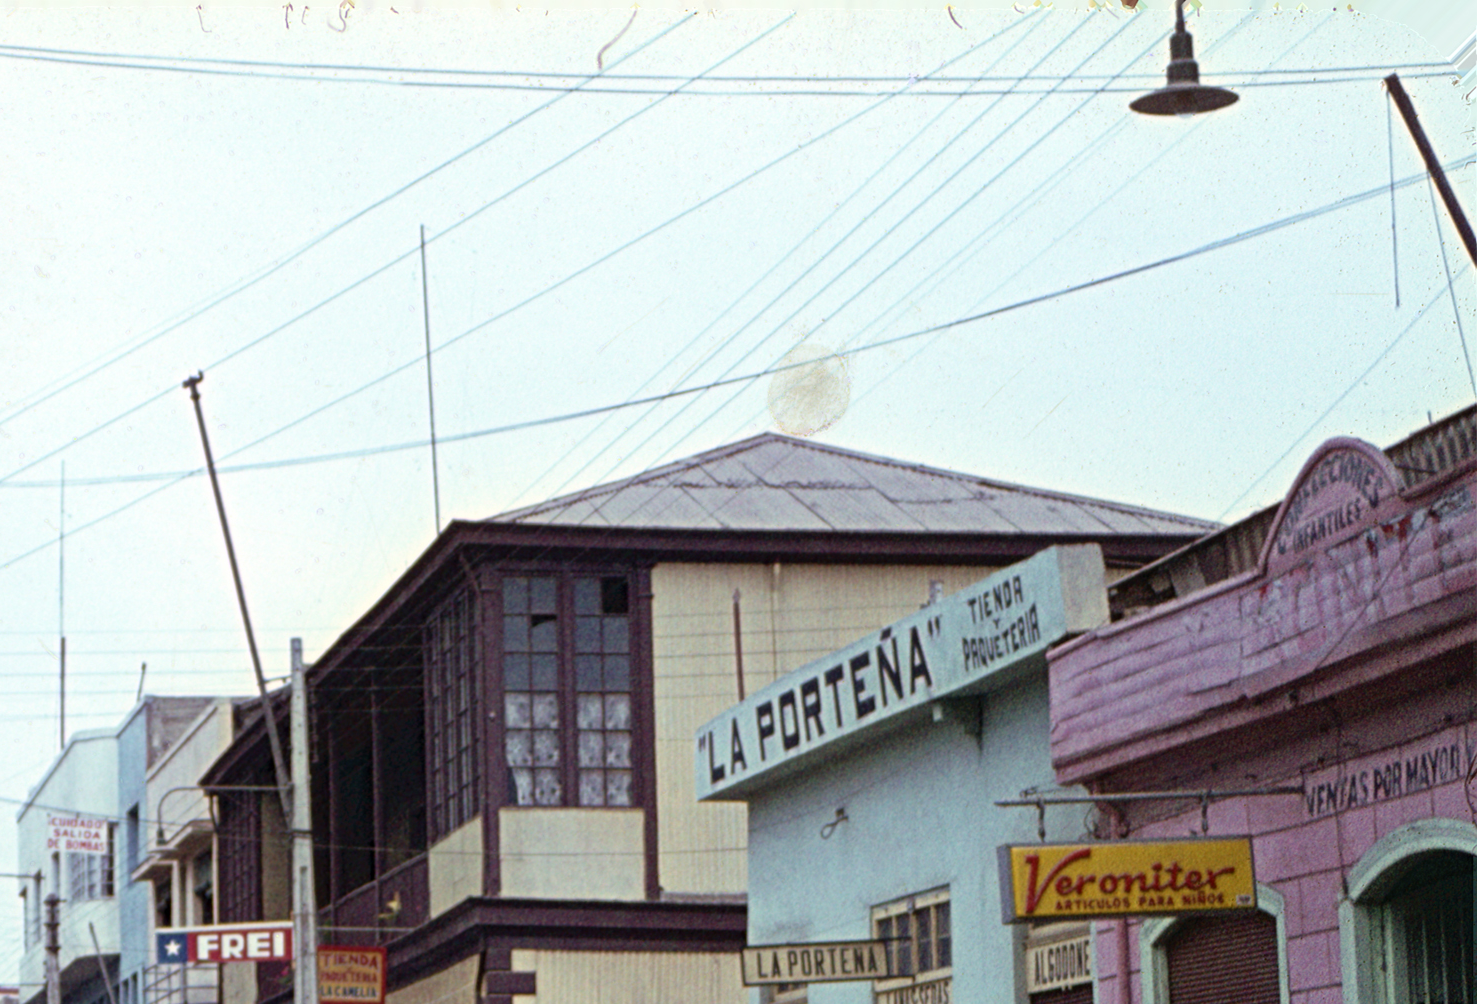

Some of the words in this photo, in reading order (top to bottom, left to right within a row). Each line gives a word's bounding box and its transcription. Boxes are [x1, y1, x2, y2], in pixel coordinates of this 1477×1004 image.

[1293, 498, 1362, 552] INFANTILES
[967, 575, 1024, 624] TIENDA
[961, 604, 1041, 672] PAQUETERIA
[1306, 771, 1368, 817] VENTAS
[1374, 761, 1402, 800] POR
[47, 838, 60, 849] DE
[65, 839, 105, 852] BOMBAS
[54, 828, 100, 840] SALIDA
[1025, 848, 1236, 915] Veroniter
[1055, 898, 1131, 912] ARTICULOS
[1138, 895, 1175, 907] PARA
[1182, 891, 1225, 906] NIÑOS
[196, 931, 285, 960] FREI
[323, 953, 378, 968] TIENDA
[757, 952, 781, 979] LA
[321, 985, 334, 998] LA
[336, 984, 377, 998] CAMELIA
